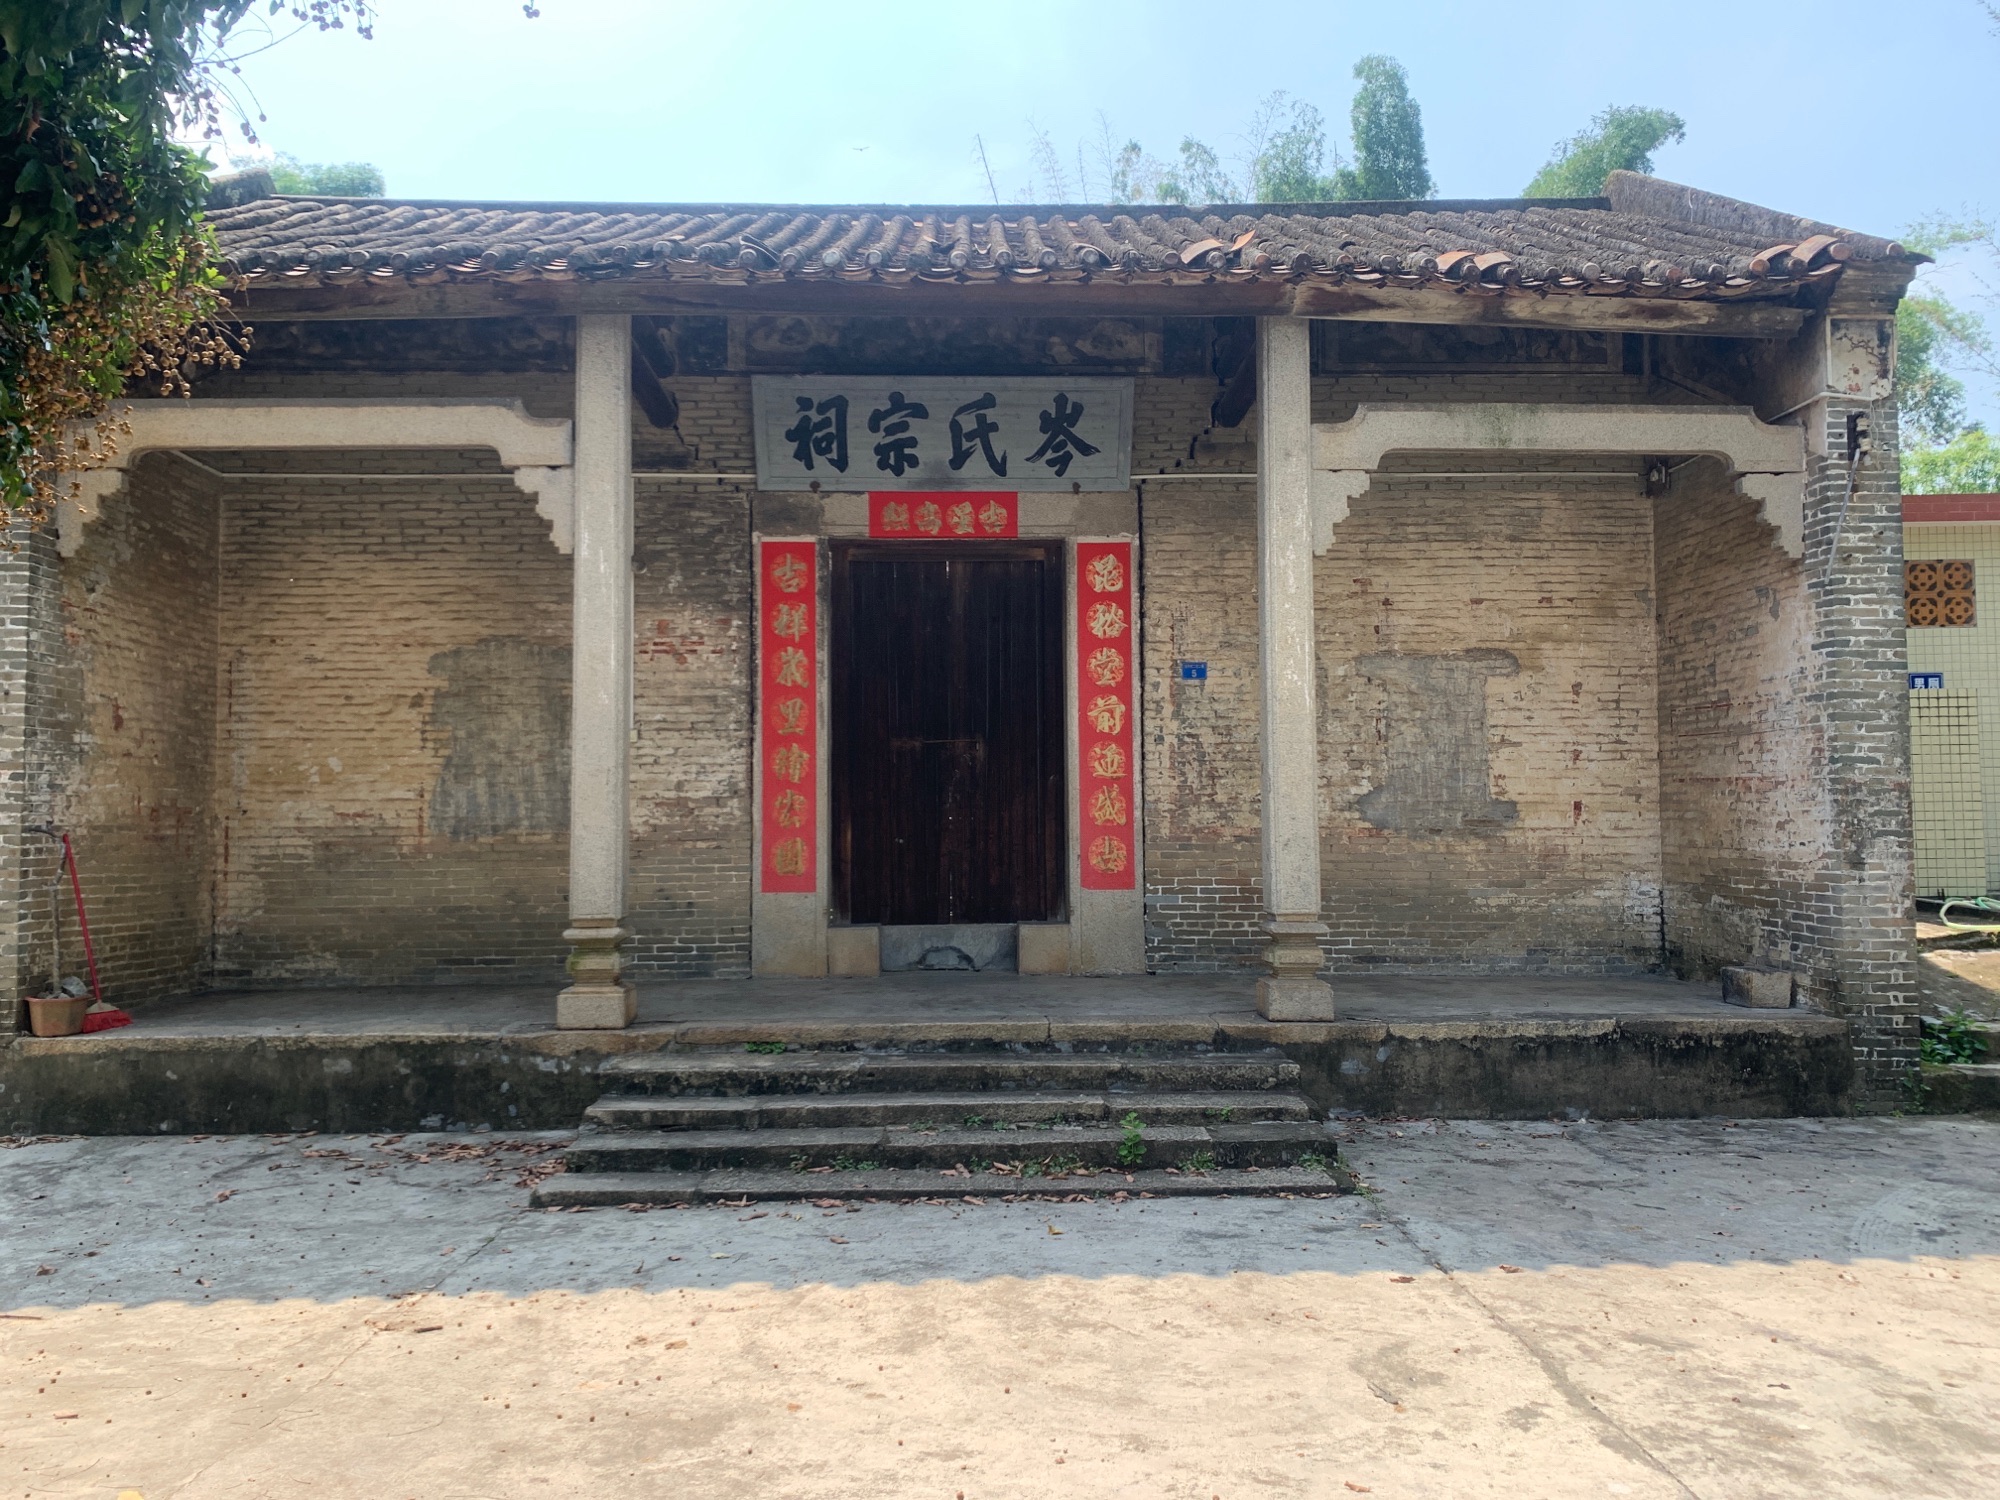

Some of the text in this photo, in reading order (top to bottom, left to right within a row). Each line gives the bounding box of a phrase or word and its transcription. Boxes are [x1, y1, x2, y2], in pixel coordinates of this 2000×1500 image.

[785, 391, 1101, 477] 岑氏宗祠
[1191, 669, 1198, 678] 5
